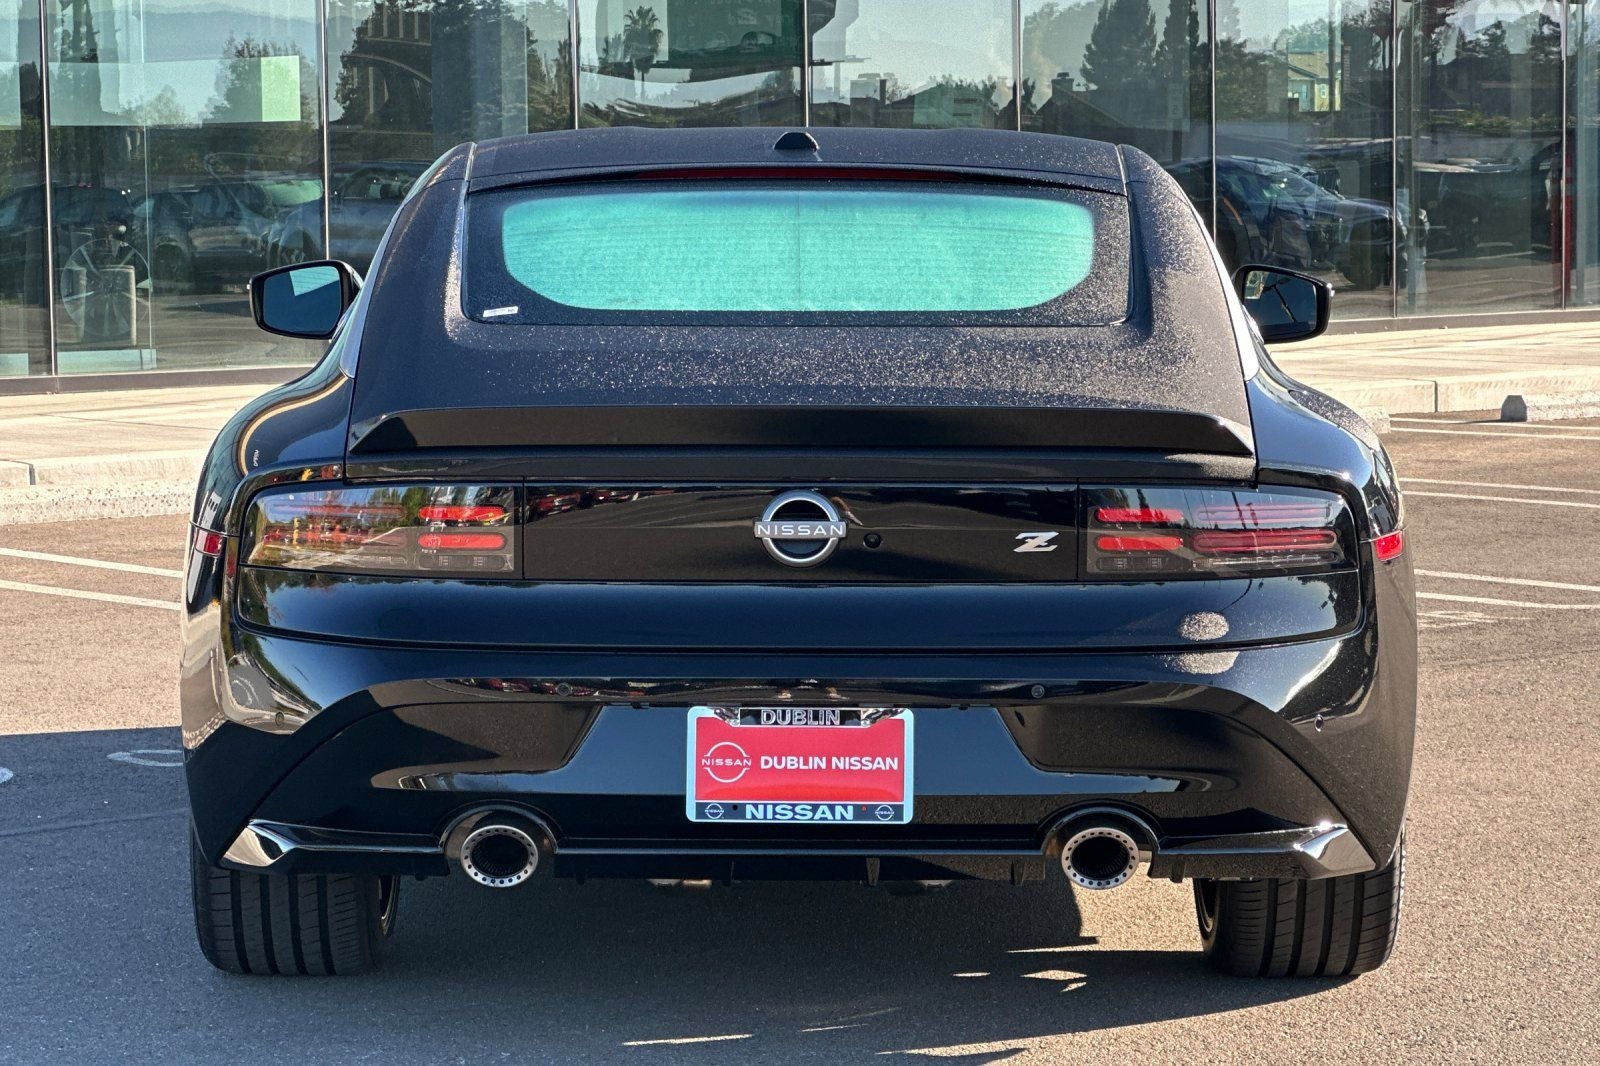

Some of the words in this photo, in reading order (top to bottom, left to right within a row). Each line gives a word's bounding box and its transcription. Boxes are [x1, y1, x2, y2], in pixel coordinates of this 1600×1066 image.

[757, 523, 844, 536] NISSAN
[1013, 531, 1060, 553] Z
[760, 708, 841, 726] DUBLIN
[701, 758, 752, 767] NISSAN
[760, 756, 827, 770] DUBLIN
[831, 756, 899, 771] NISSAN
[745, 804, 854, 821] NISSAN
